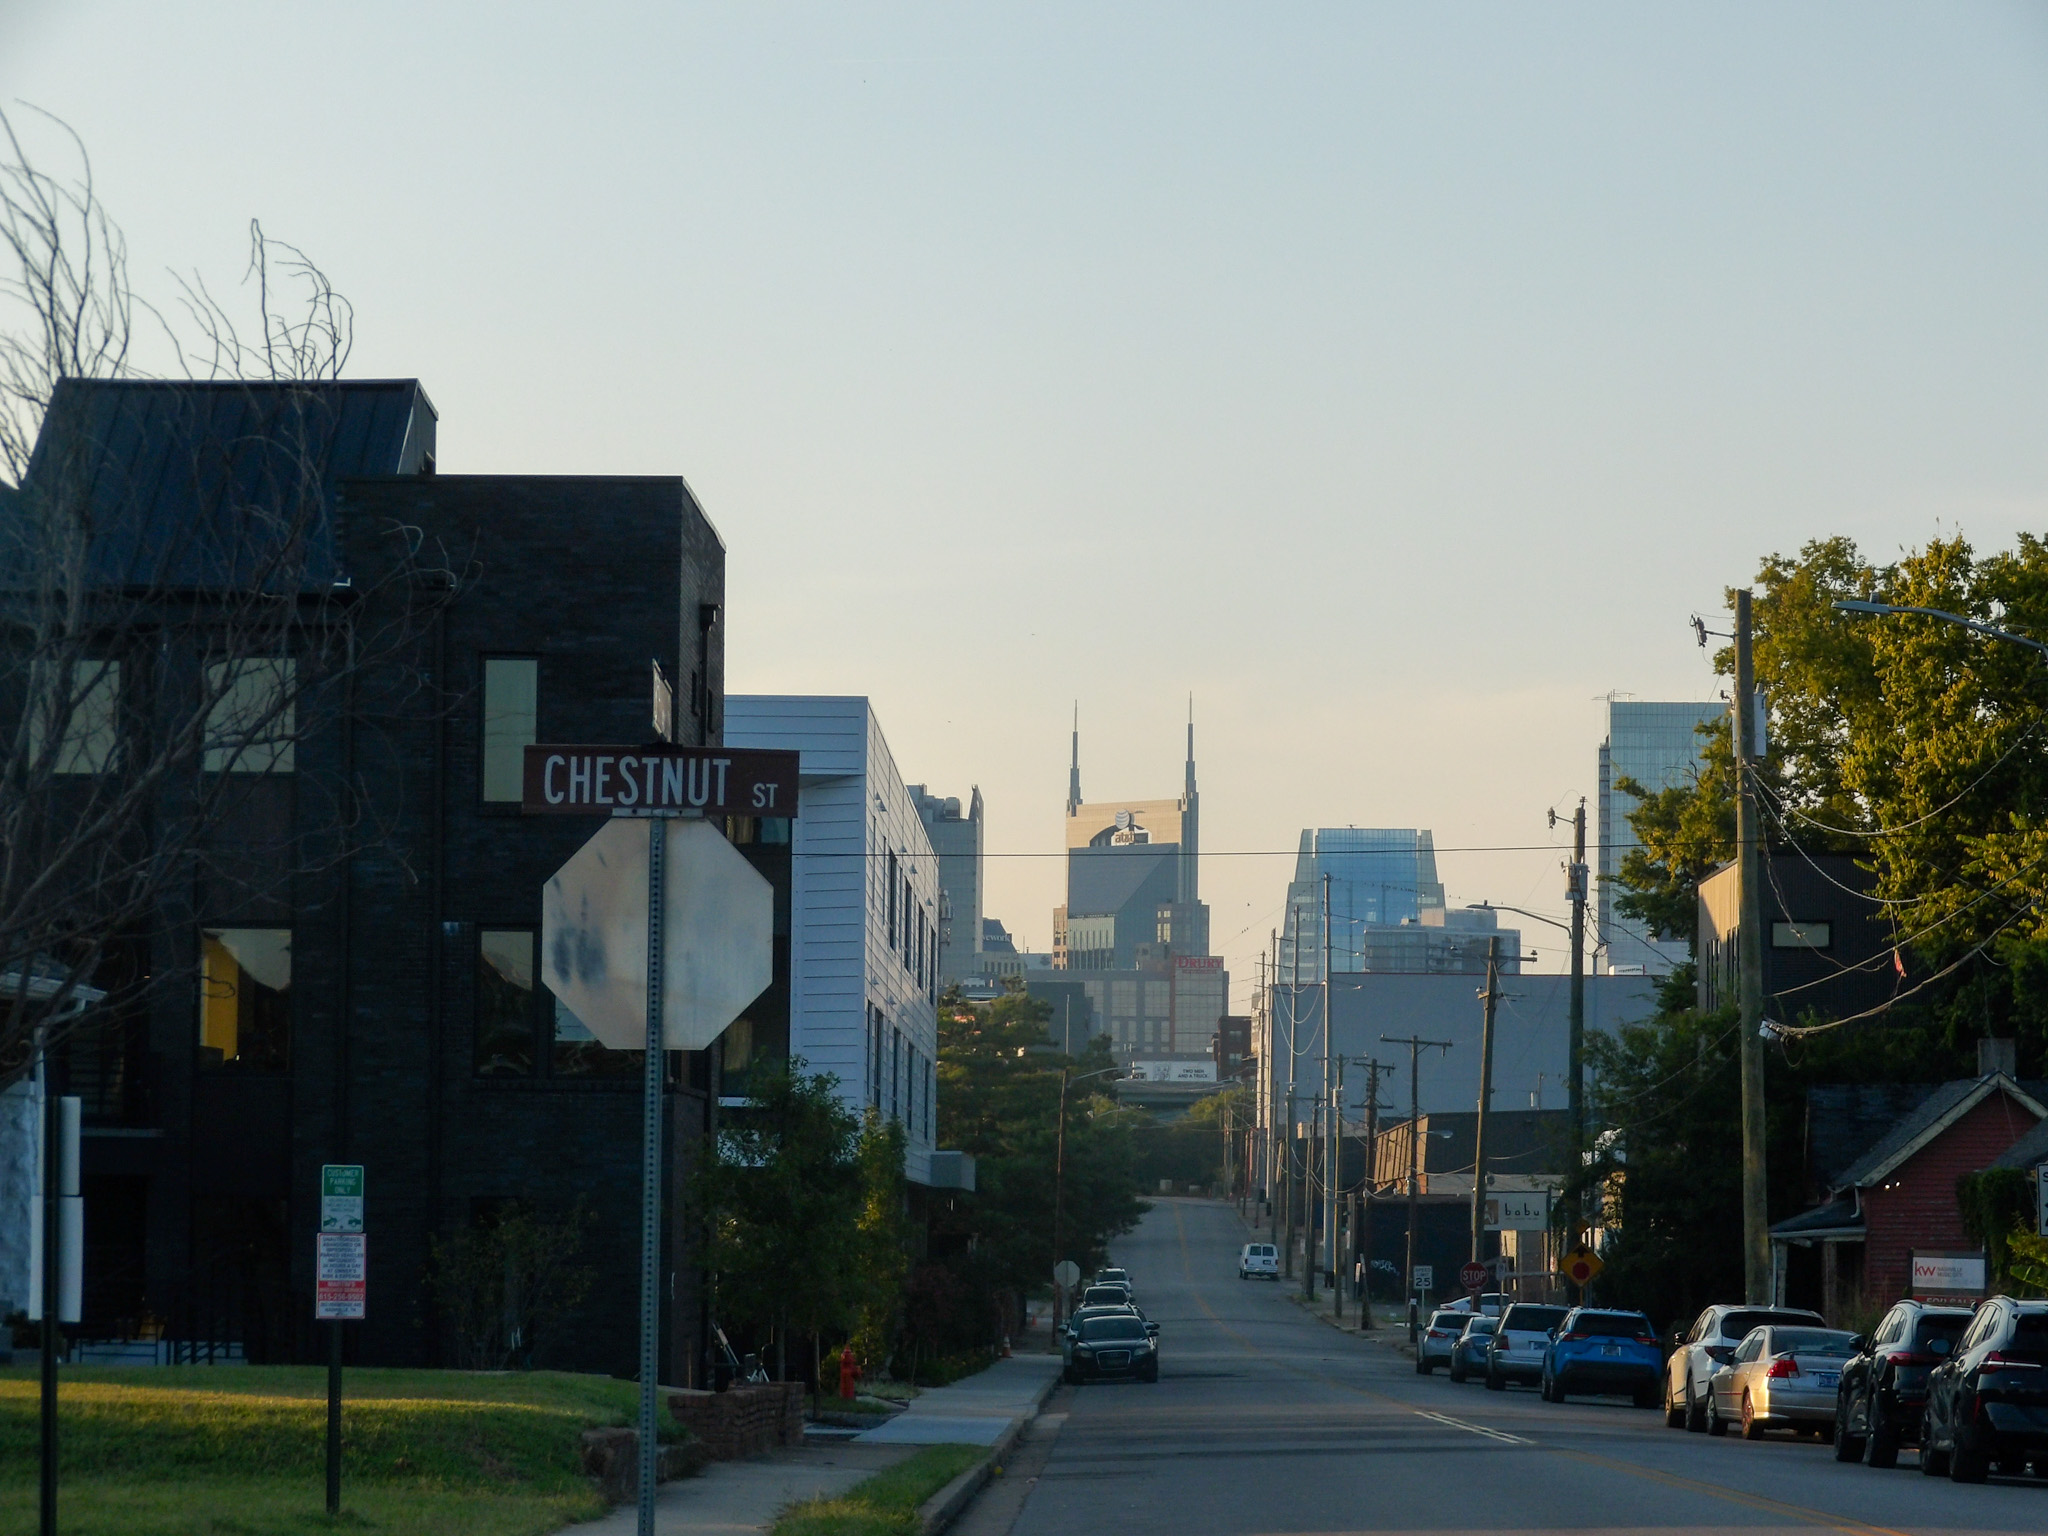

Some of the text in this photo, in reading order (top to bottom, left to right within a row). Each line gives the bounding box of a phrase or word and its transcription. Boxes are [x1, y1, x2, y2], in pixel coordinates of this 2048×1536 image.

[544, 755, 778, 808] CHESTNUT ST
[1177, 956, 1223, 968] DRURY
[327, 1169, 359, 1177] CUSTOMER
[330, 1177, 356, 1185] PARKING
[335, 1186, 351, 1194] ONLY
[1505, 1203, 1539, 1216] babu
[1463, 1270, 1486, 1281] STOP
[1416, 1278, 1430, 1286] 25
